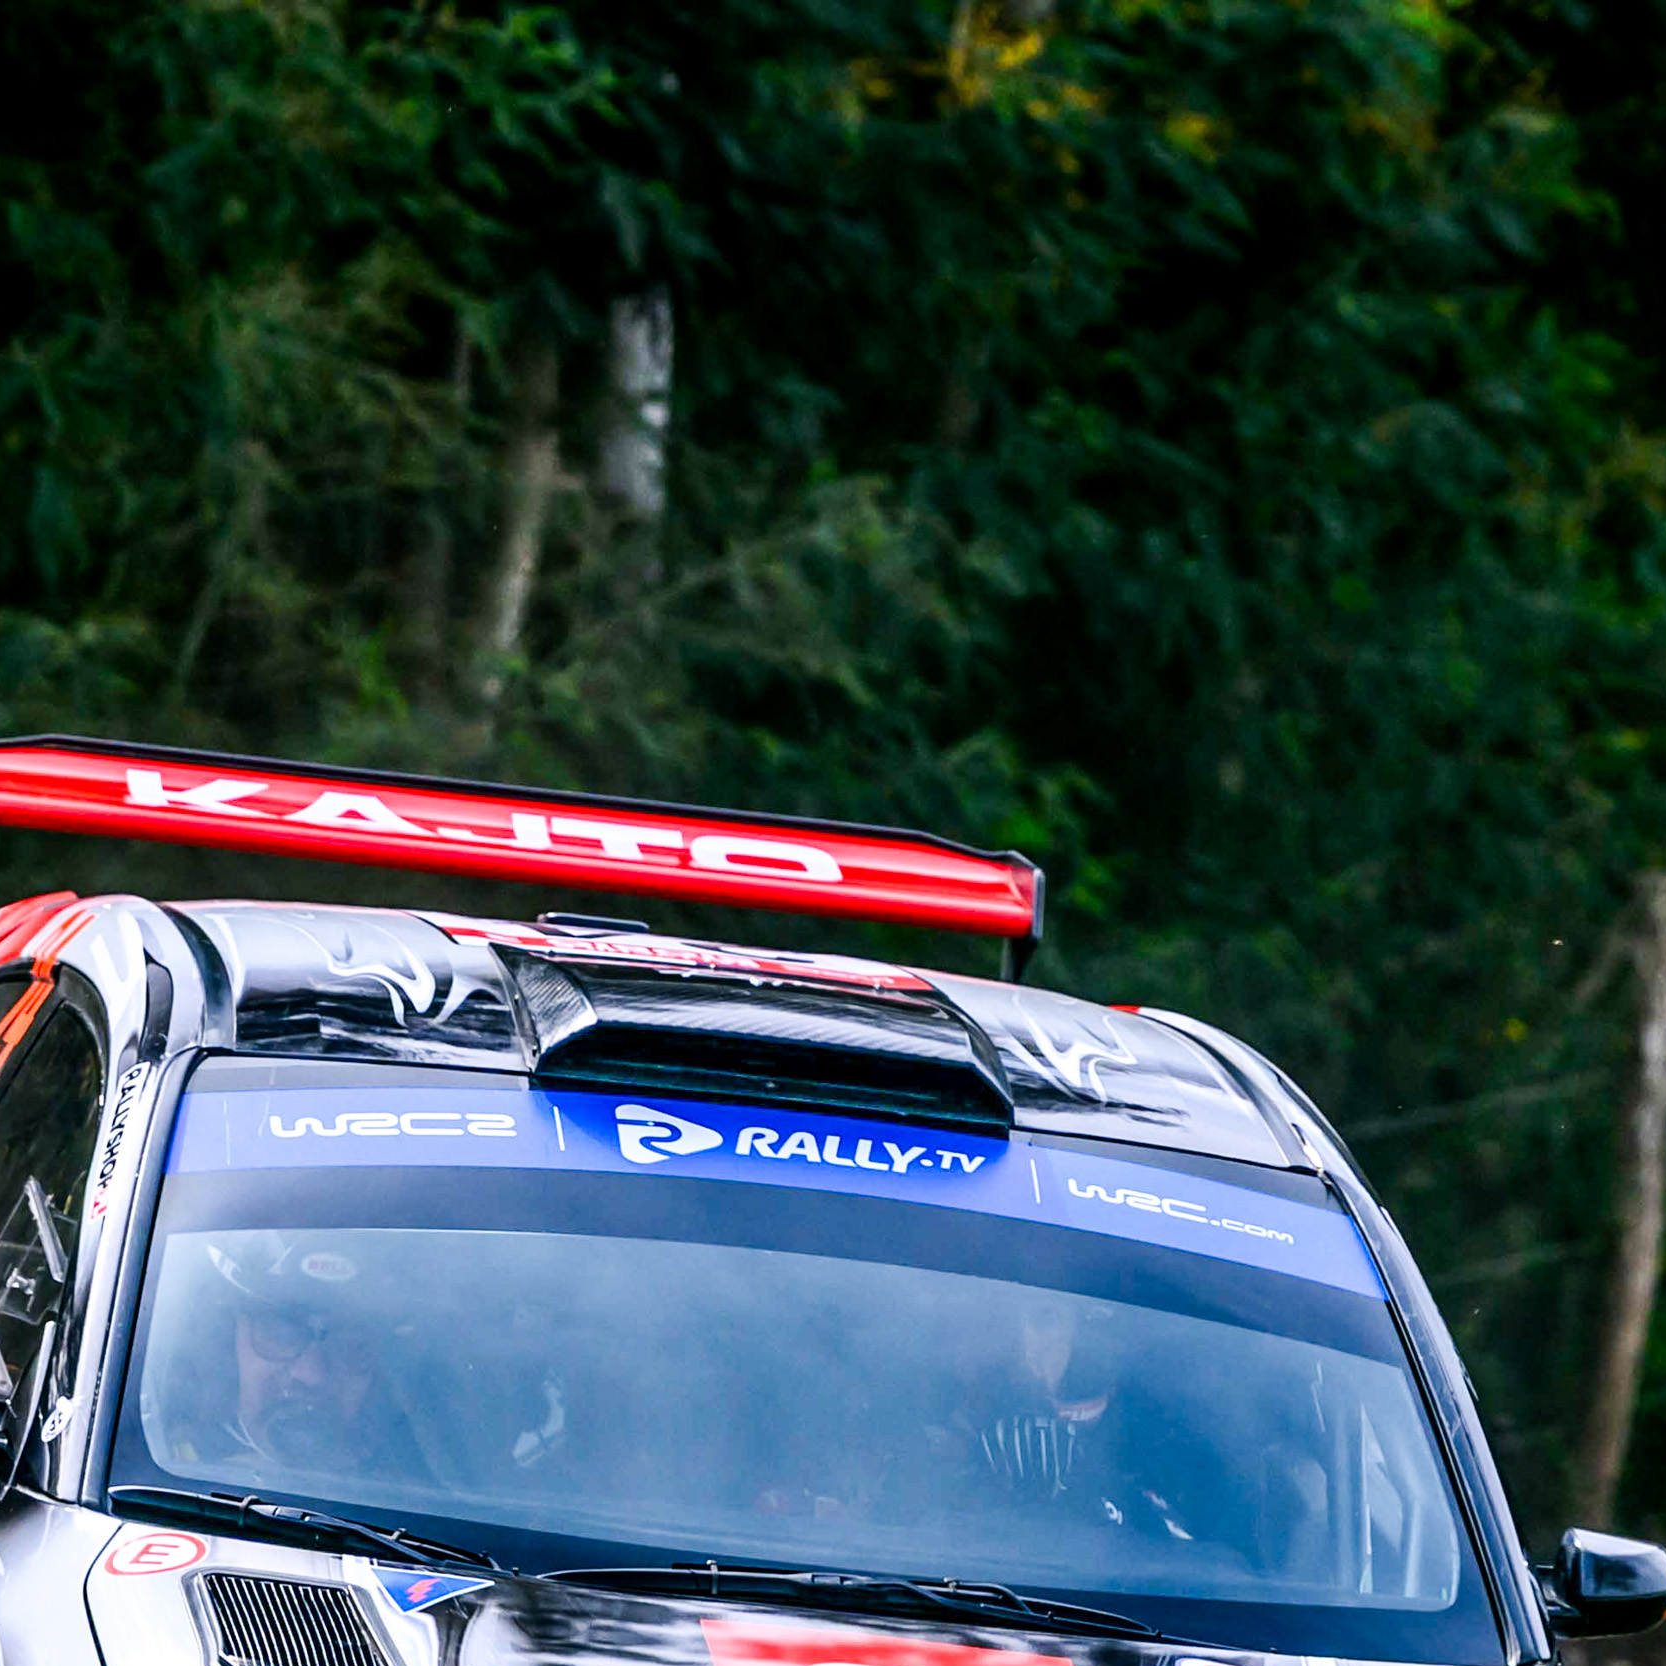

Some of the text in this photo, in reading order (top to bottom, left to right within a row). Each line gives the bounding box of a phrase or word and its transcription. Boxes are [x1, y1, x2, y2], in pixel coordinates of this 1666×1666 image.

[124, 769, 844, 883] KAJTO
[269, 1112, 517, 1137] WRC2
[128, 1544, 169, 1565] E
